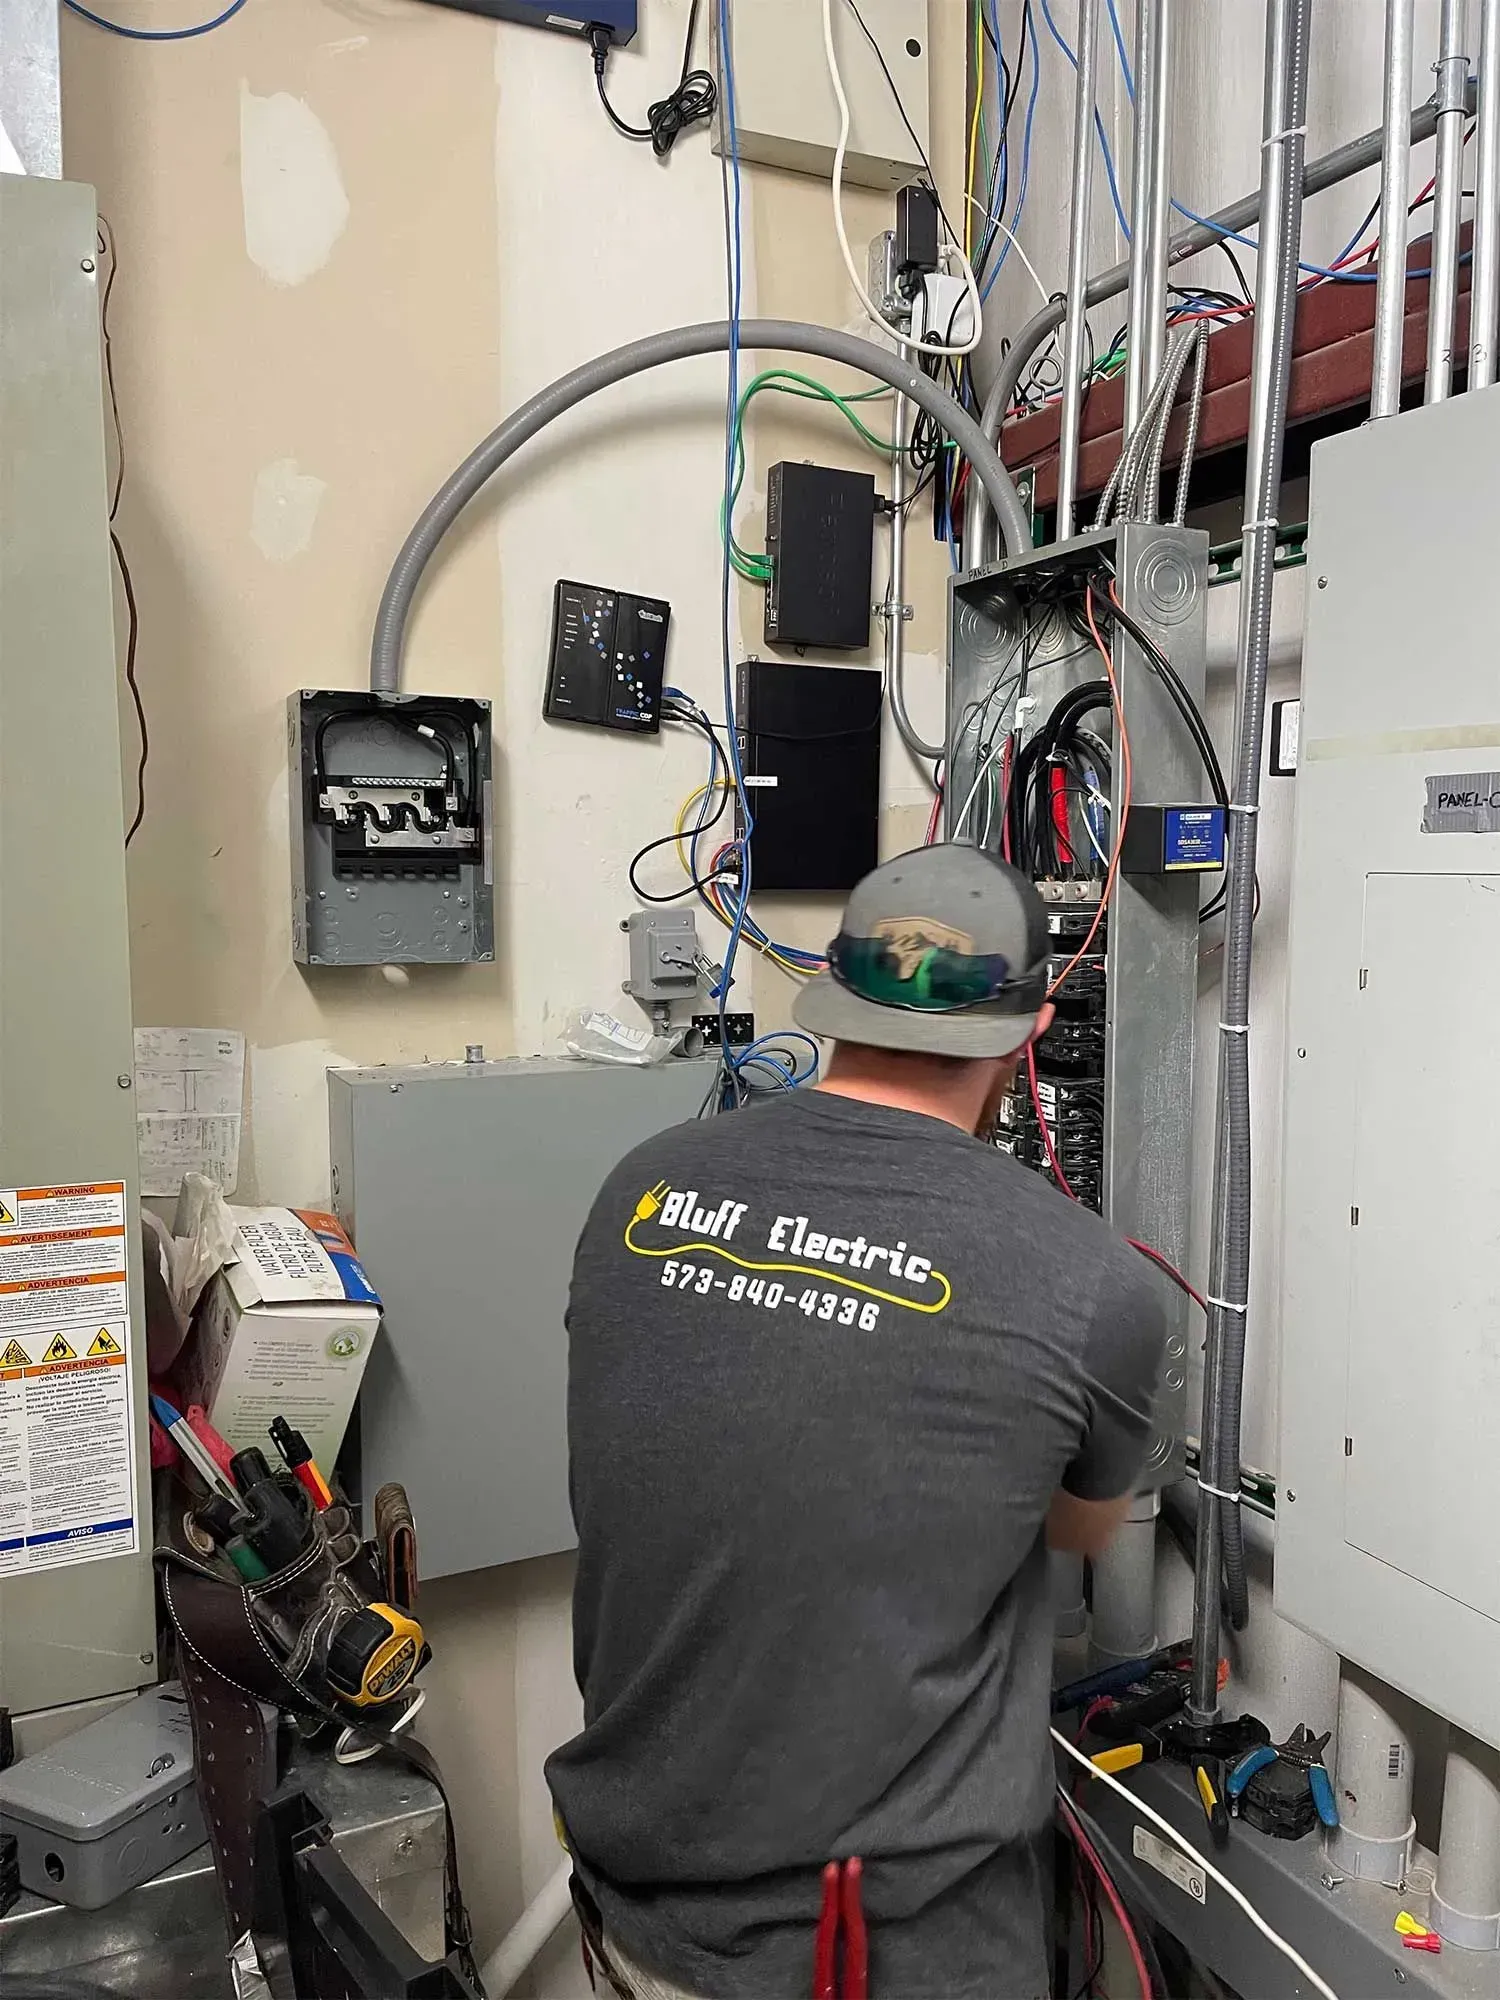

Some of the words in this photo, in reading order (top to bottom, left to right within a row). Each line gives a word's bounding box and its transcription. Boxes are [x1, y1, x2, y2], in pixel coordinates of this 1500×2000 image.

[967, 566, 992, 581] PANEL
[1002, 560, 1008, 570] D
[54, 1187, 95, 1196] WARNING
[20, 1230, 92, 1243] AVERTISSEMENT
[239, 1224, 268, 1247] FILTER
[259, 1221, 286, 1242] AGUA
[283, 1226, 306, 1241] EAU
[658, 1190, 749, 1241] Bluff
[767, 1216, 932, 1284] Electric
[271, 1242, 292, 1253] DE
[253, 1248, 283, 1277] WATER
[278, 1253, 308, 1279] FILTRO
[298, 1249, 328, 1274] FILTRE
[27, 1277, 90, 1289] ADVERTENCIA
[660, 1260, 880, 1332] 573-840-4336
[49, 1359, 109, 1372] ADVERTENCIA
[67, 1527, 94, 1538] AVISO
